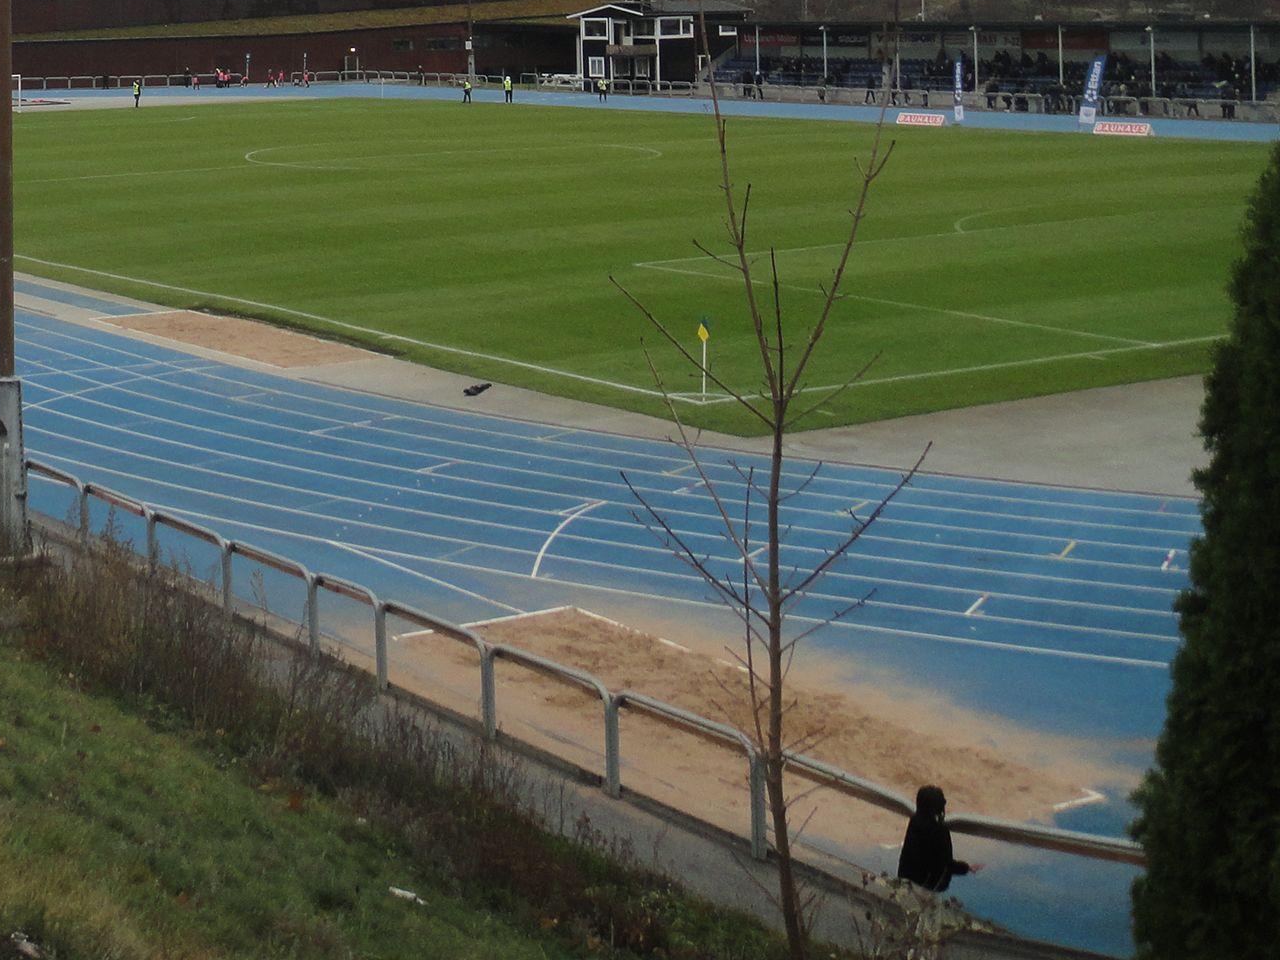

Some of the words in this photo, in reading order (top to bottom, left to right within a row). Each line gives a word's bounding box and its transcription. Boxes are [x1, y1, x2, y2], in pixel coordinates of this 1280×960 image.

[1088, 61, 1102, 89] Ettan
[898, 114, 942, 125] BAUHAUS
[1096, 123, 1147, 134] BAUHAUS
